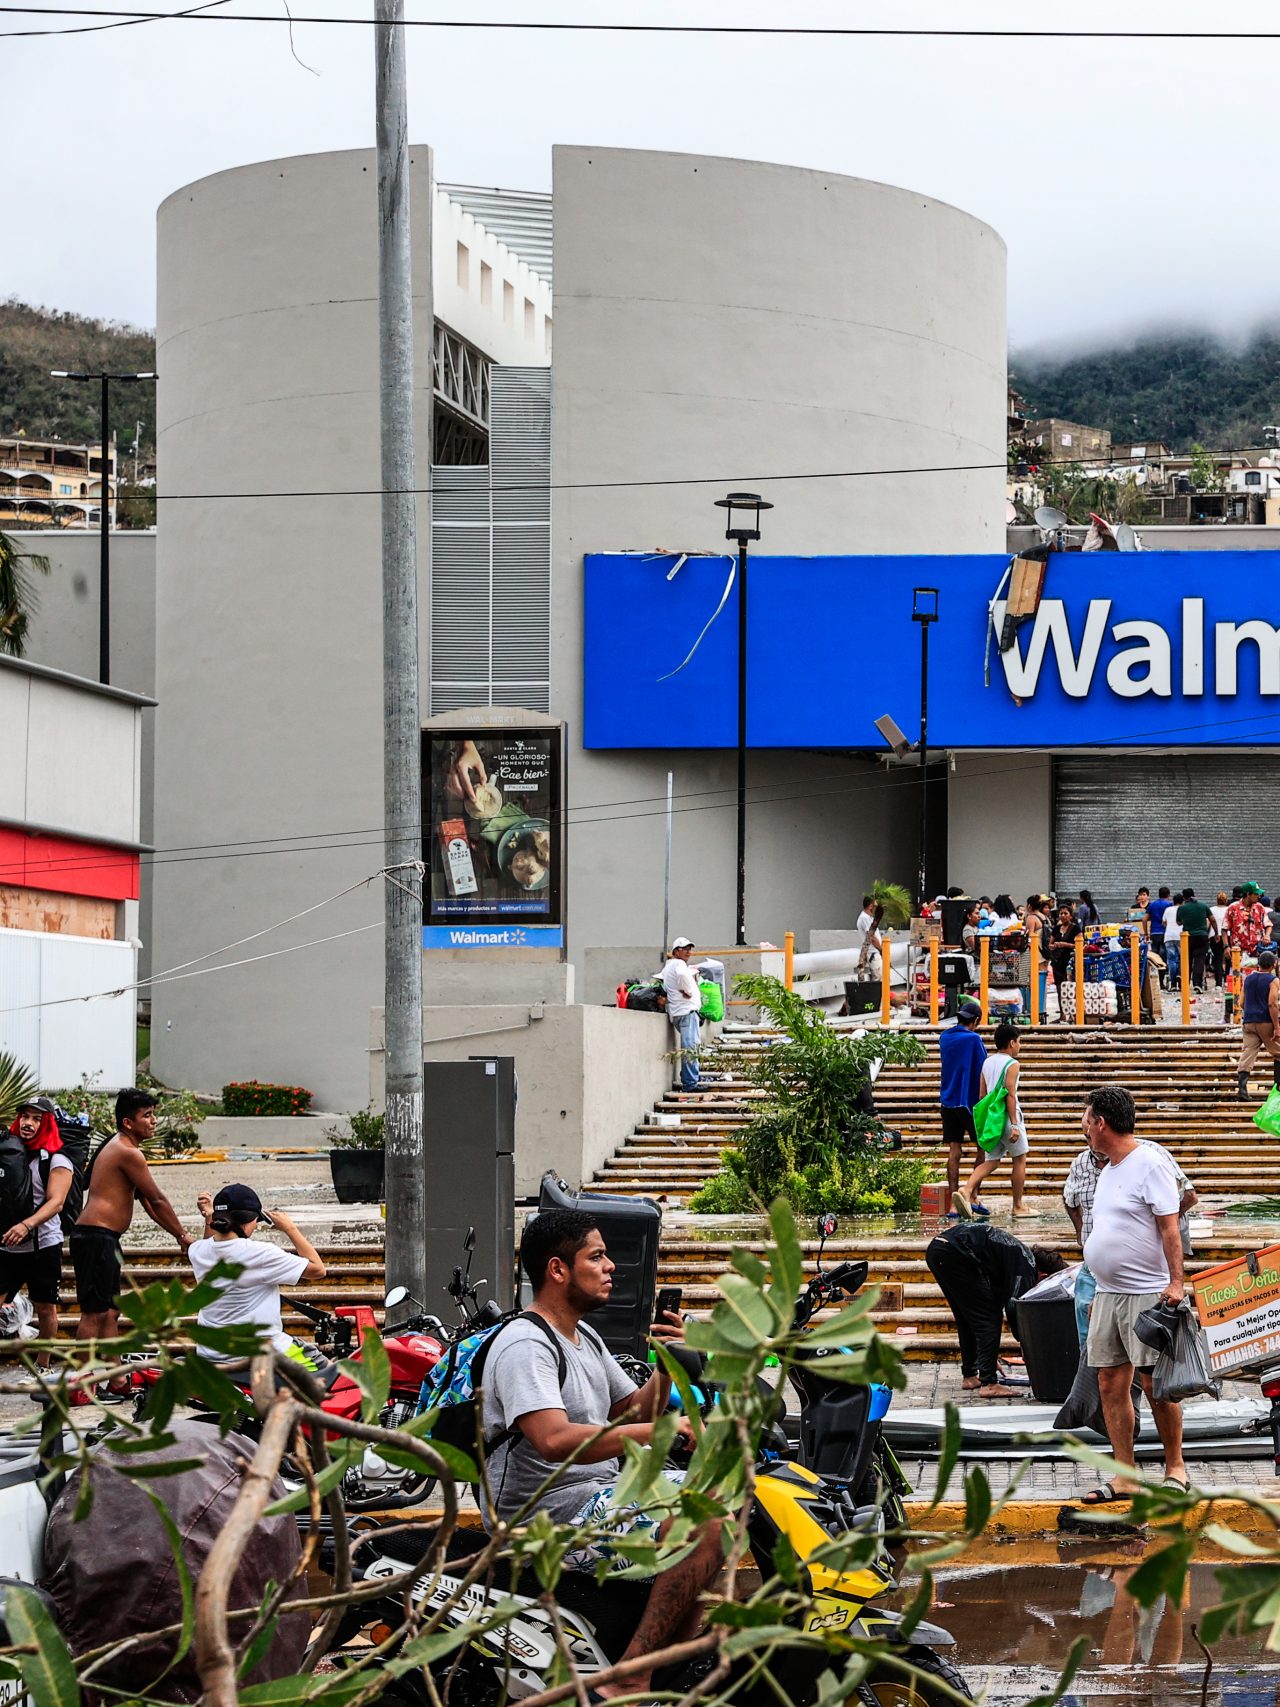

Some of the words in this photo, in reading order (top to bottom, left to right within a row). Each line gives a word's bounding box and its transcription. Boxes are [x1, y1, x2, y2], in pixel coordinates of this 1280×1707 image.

[500, 766, 522, 780] Cae
[523, 768, 545, 780] bien
[450, 931, 510, 944] Walmart
[1197, 1284, 1238, 1307] Tacos
[1237, 1268, 1280, 1293] Doña
[1244, 1297, 1253, 1305] EN
[1253, 1291, 1271, 1302] TACOS
[1271, 1288, 1280, 1296] DE
[1236, 1320, 1245, 1329] Tu
[1246, 1313, 1267, 1328] Mejor
[1213, 1337, 1231, 1348] Para
[1232, 1324, 1266, 1342] cualquier
[1266, 1319, 1280, 1333] tipo
